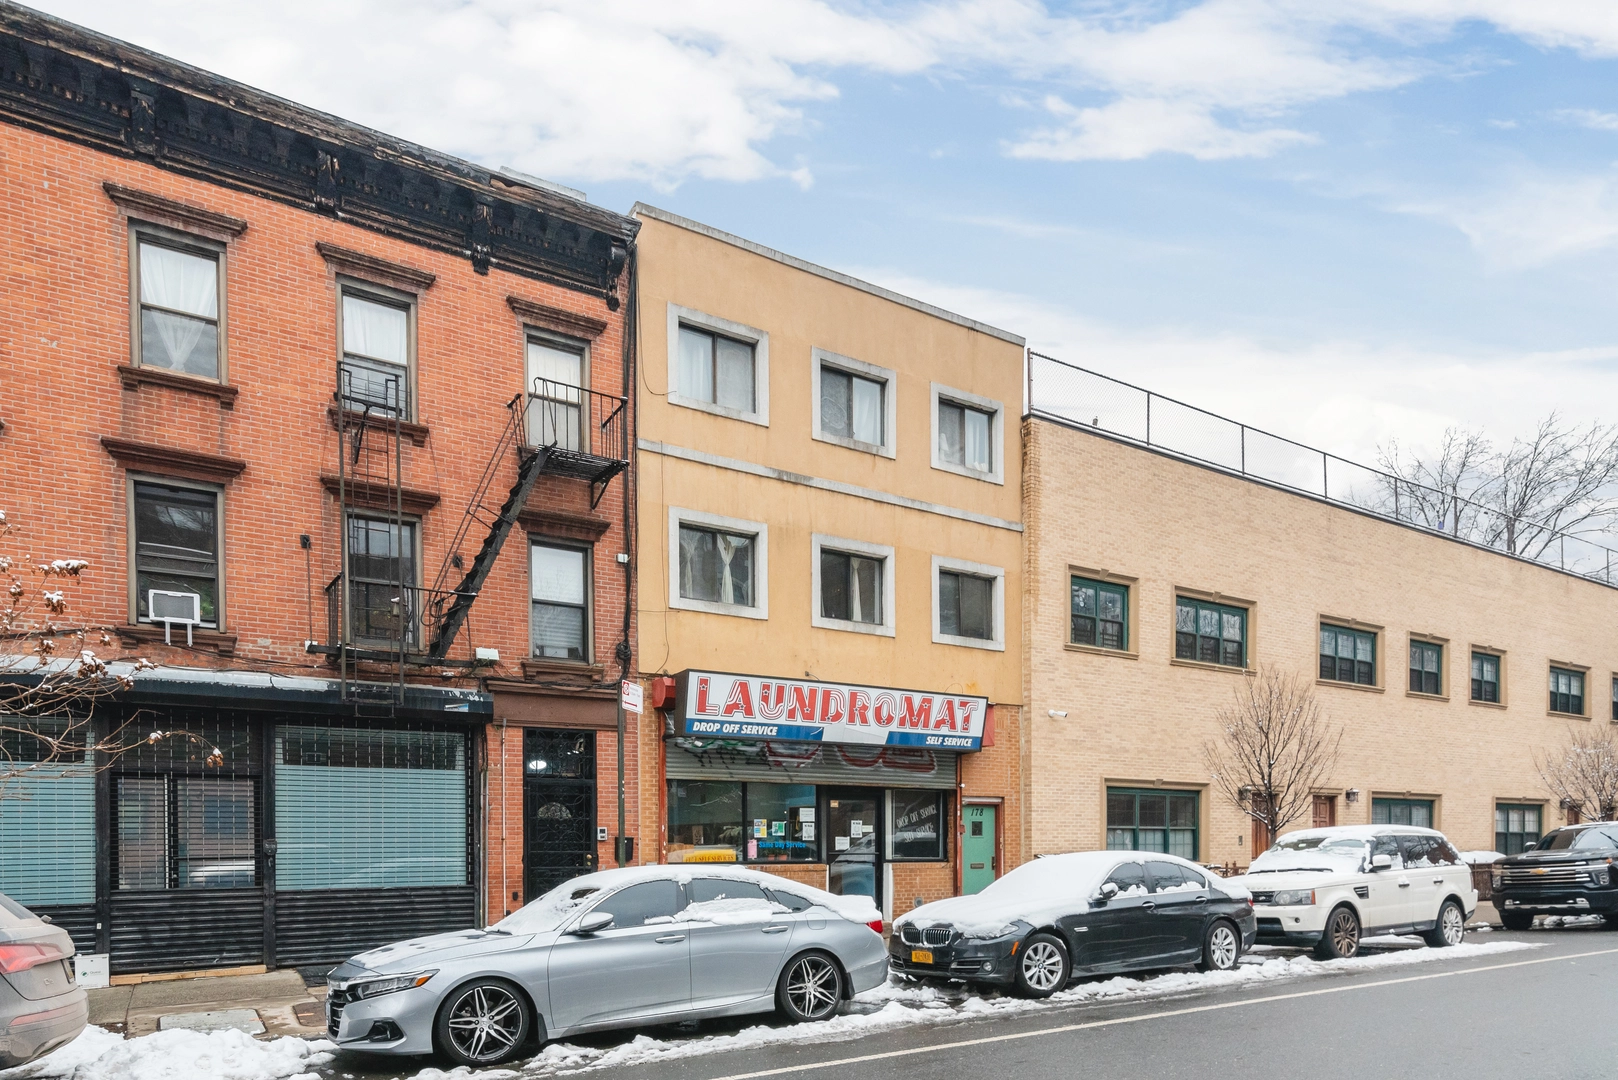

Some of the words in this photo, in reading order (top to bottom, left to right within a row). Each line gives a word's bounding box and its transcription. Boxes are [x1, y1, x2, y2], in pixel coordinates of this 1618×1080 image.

[695, 675, 979, 733] LAUNDROMAT
[693, 721, 720, 732] DROP
[722, 723, 740, 734] OFF
[741, 724, 778, 736] SERVICE
[926, 736, 943, 745] SELF
[943, 737, 973, 747] SERVICE
[896, 815, 909, 828] DROP
[920, 804, 937, 819] SERVICE
[970, 807, 984, 816] 178
[915, 822, 934, 838] SERVICE
[775, 841, 785, 849] Day
